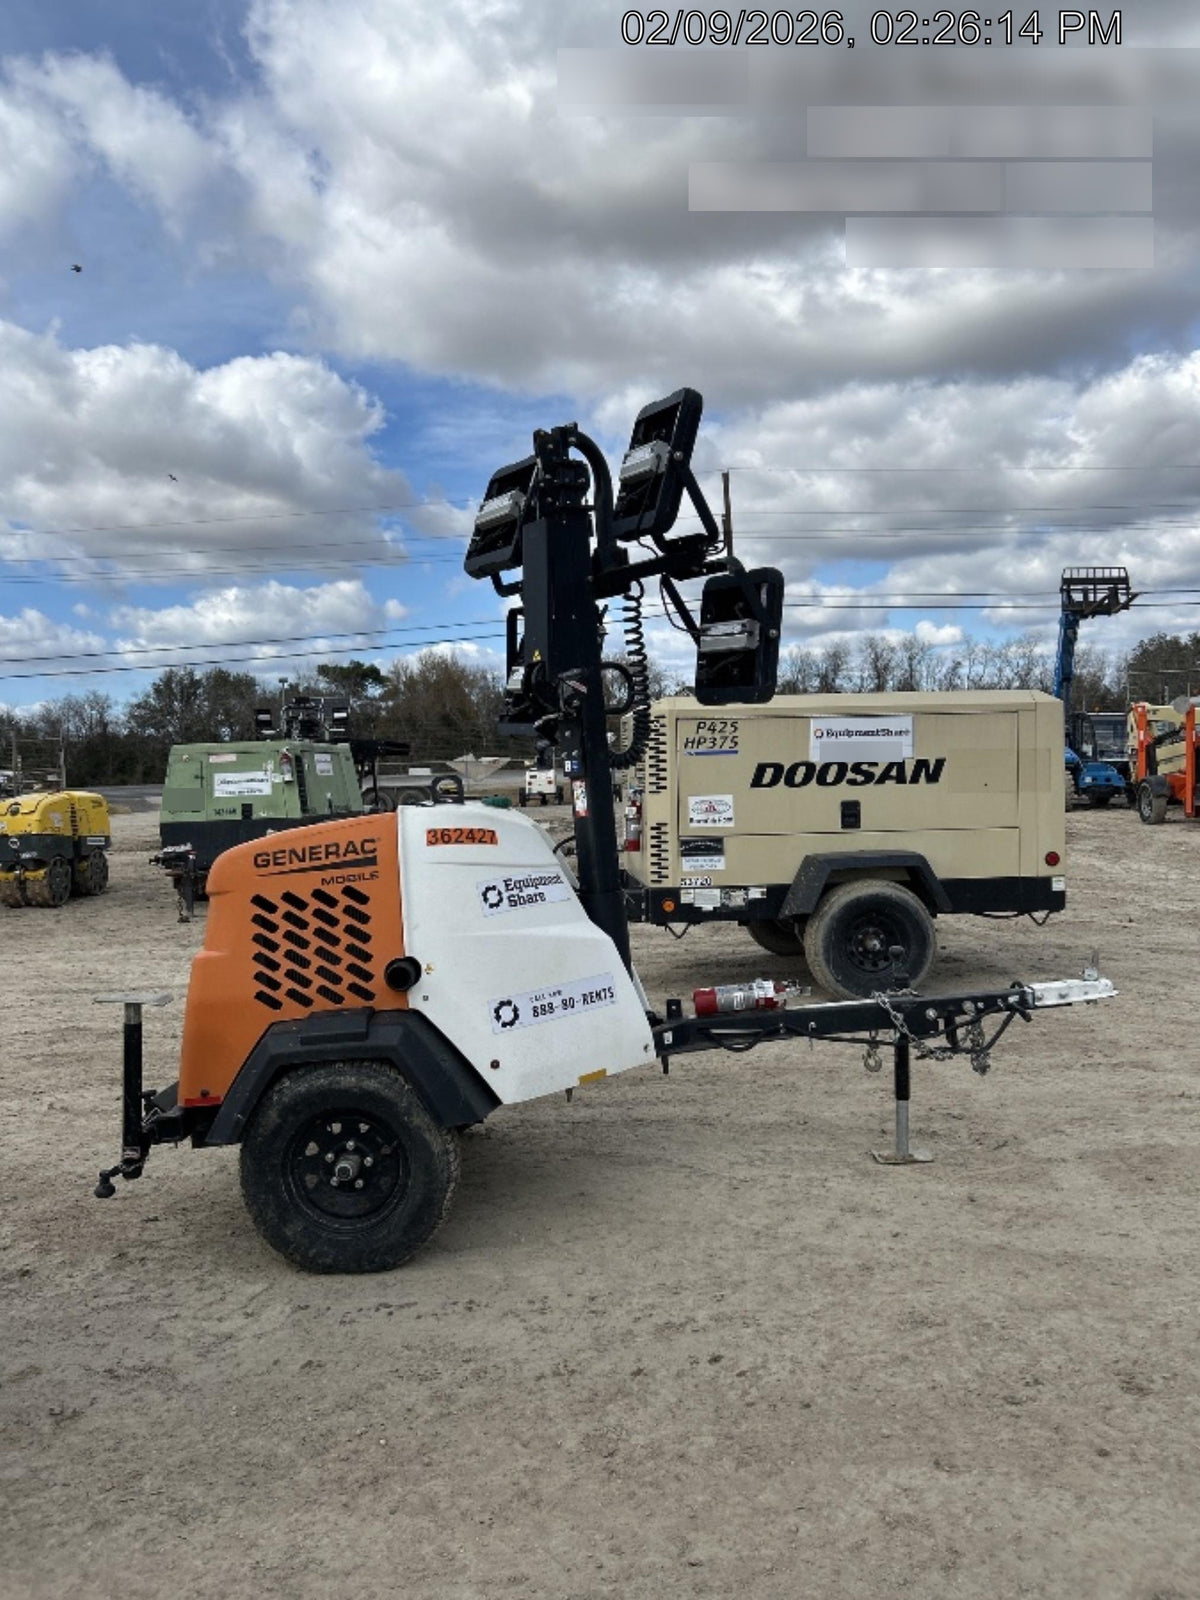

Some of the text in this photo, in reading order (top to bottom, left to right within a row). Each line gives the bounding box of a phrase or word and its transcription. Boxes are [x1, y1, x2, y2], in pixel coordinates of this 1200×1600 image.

[696, 721, 739, 735] P425
[684, 735, 739, 750] HP375
[749, 757, 946, 788] DOOSAN
[427, 828, 496, 845] 362427
[254, 838, 377, 869] GENERAC
[321, 871, 379, 886] MOBILE
[507, 892, 546, 908] Share
